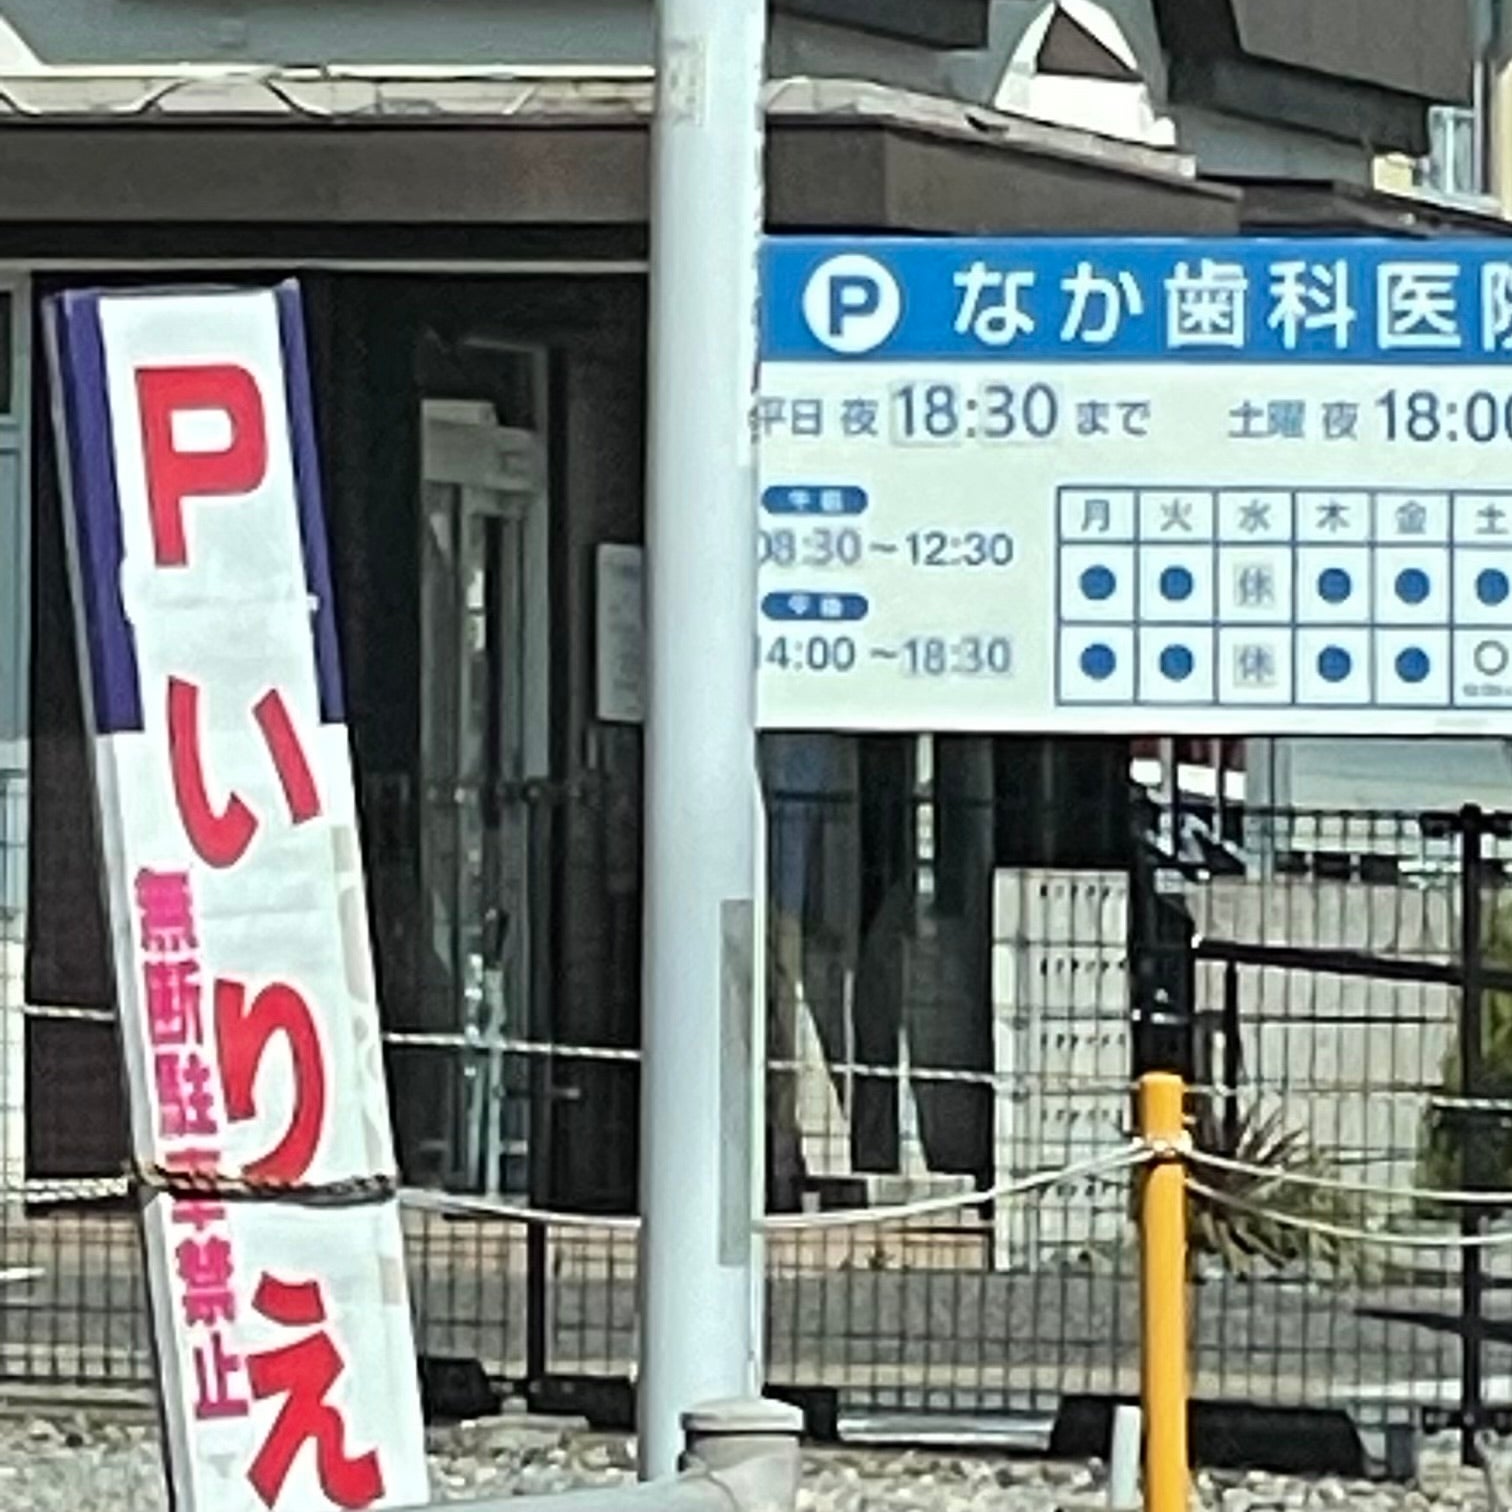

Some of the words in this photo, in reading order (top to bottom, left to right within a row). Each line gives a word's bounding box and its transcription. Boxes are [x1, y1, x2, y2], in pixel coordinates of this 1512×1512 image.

[840, 398, 879, 437] 夜
[895, 381, 1059, 438] 18:30
[1075, 398, 1152, 437] まで
[1228, 399, 1306, 440] 土曜
[1321, 401, 1359, 441] 夜
[1081, 498, 1111, 533] 月
[1158, 498, 1194, 533] 火
[1237, 498, 1273, 534] 水
[1315, 499, 1351, 534] 木
[1395, 499, 1428, 536] 金
[1475, 503, 1510, 536] 土
